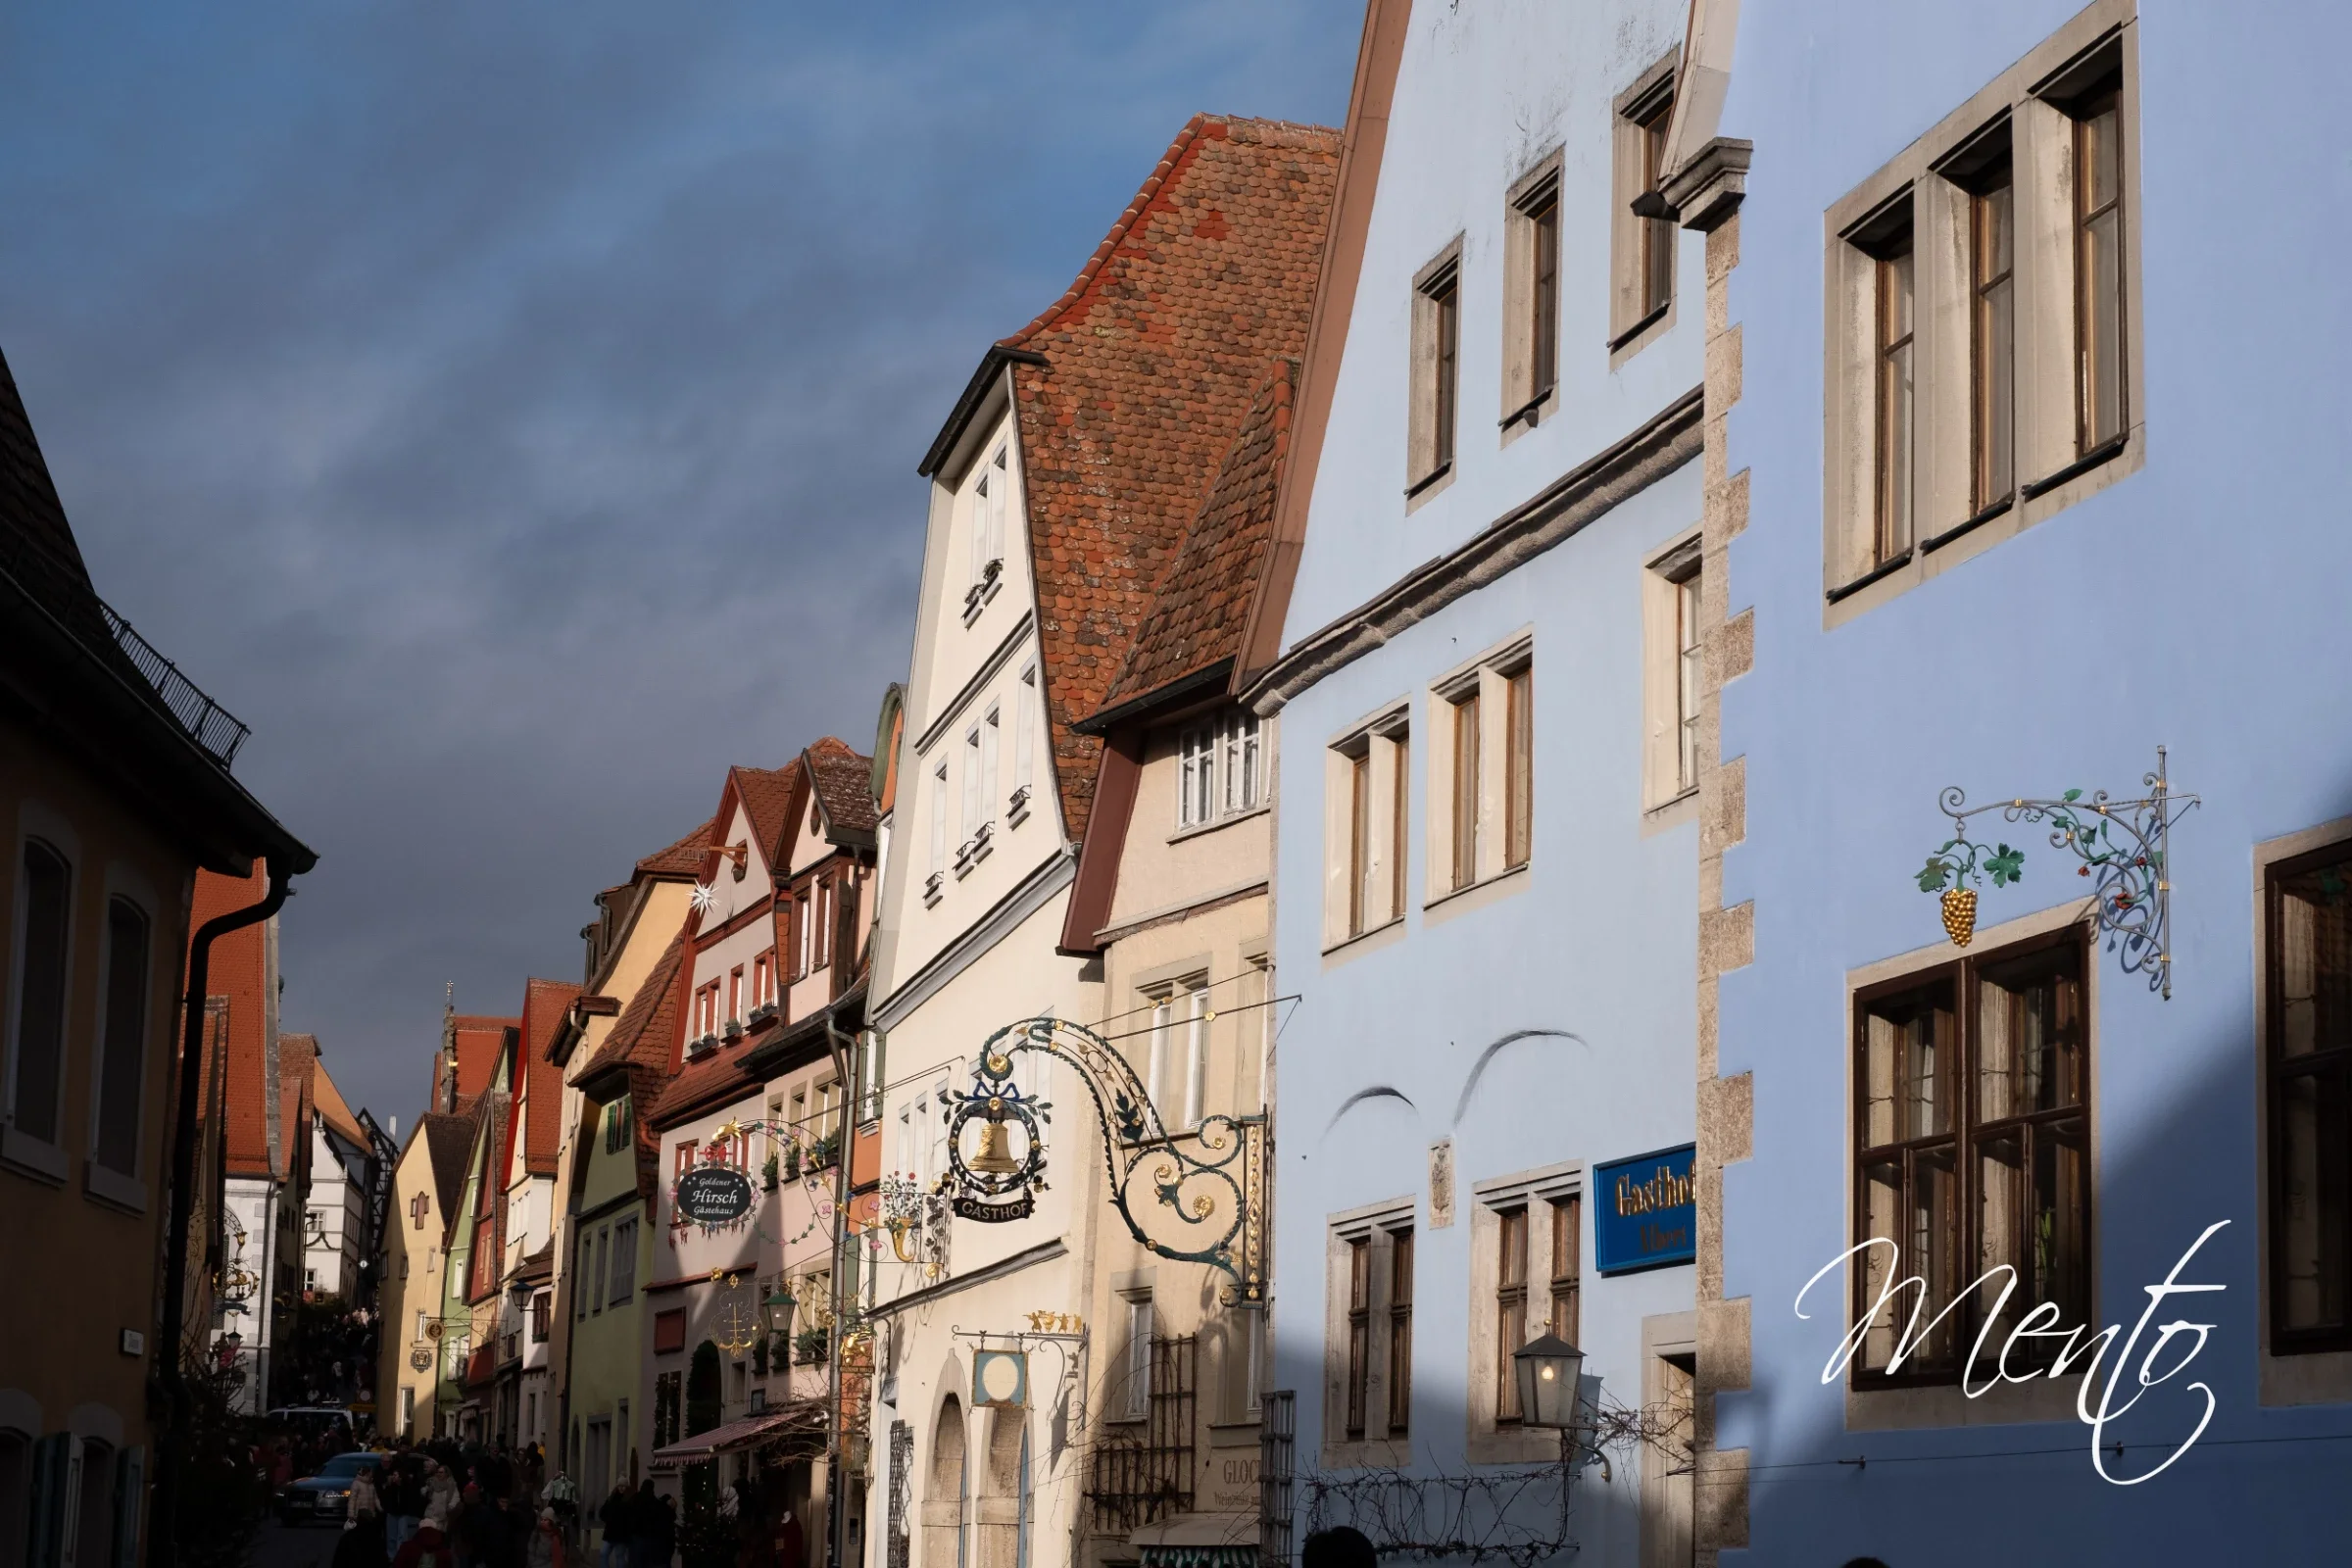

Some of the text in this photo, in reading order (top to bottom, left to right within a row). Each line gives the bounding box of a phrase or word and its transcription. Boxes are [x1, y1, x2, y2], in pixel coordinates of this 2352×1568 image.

[699, 1177, 732, 1187] Goldener
[691, 1189, 738, 1204] Hirsch
[694, 1205, 734, 1216] Gästehaus
[961, 1201, 1028, 1220] GASTHOF
[1223, 1459, 1261, 1485] GLOC
